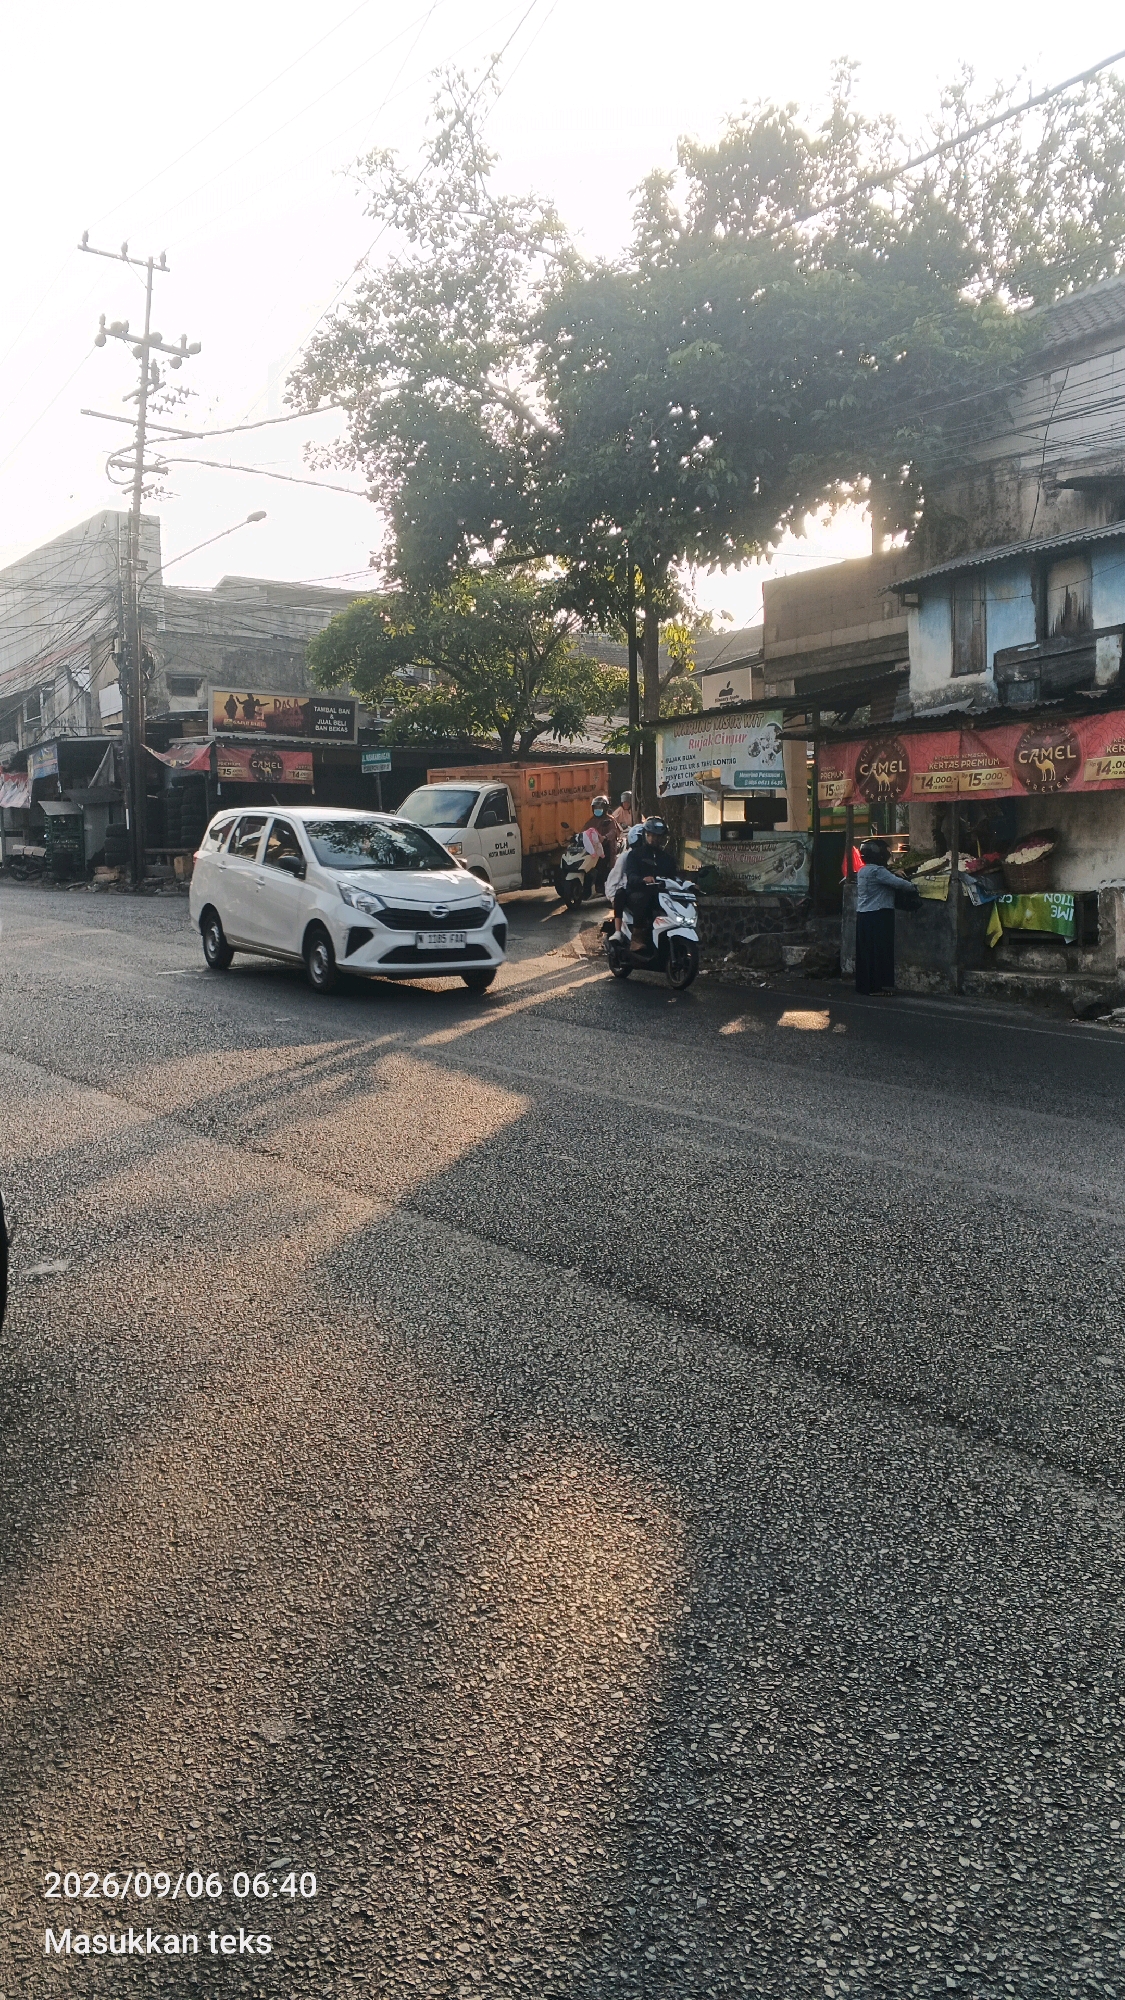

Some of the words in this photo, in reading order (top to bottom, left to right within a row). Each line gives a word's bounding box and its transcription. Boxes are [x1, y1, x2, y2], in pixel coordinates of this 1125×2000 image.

[314, 706, 337, 714] TAMBAL
[338, 707, 350, 715] BAN
[328, 725, 348, 733] BEKAS
[674, 718, 712, 738] WARUNG
[743, 712, 765, 729] WIT
[689, 734, 713, 751] Rujak
[714, 732, 748, 747] Cingur
[1018, 744, 1077, 764] CAMEL
[251, 760, 282, 769] CAMEL
[859, 760, 907, 775] CAMEL
[928, 760, 960, 770] KERTAS
[960, 757, 1000, 768] PREMIUM
[1025, 775, 1071, 793] KRETEK
[865, 787, 901, 802] KRETEK
[494, 842, 508, 850] DLH
[499, 848, 516, 857] MALANG
